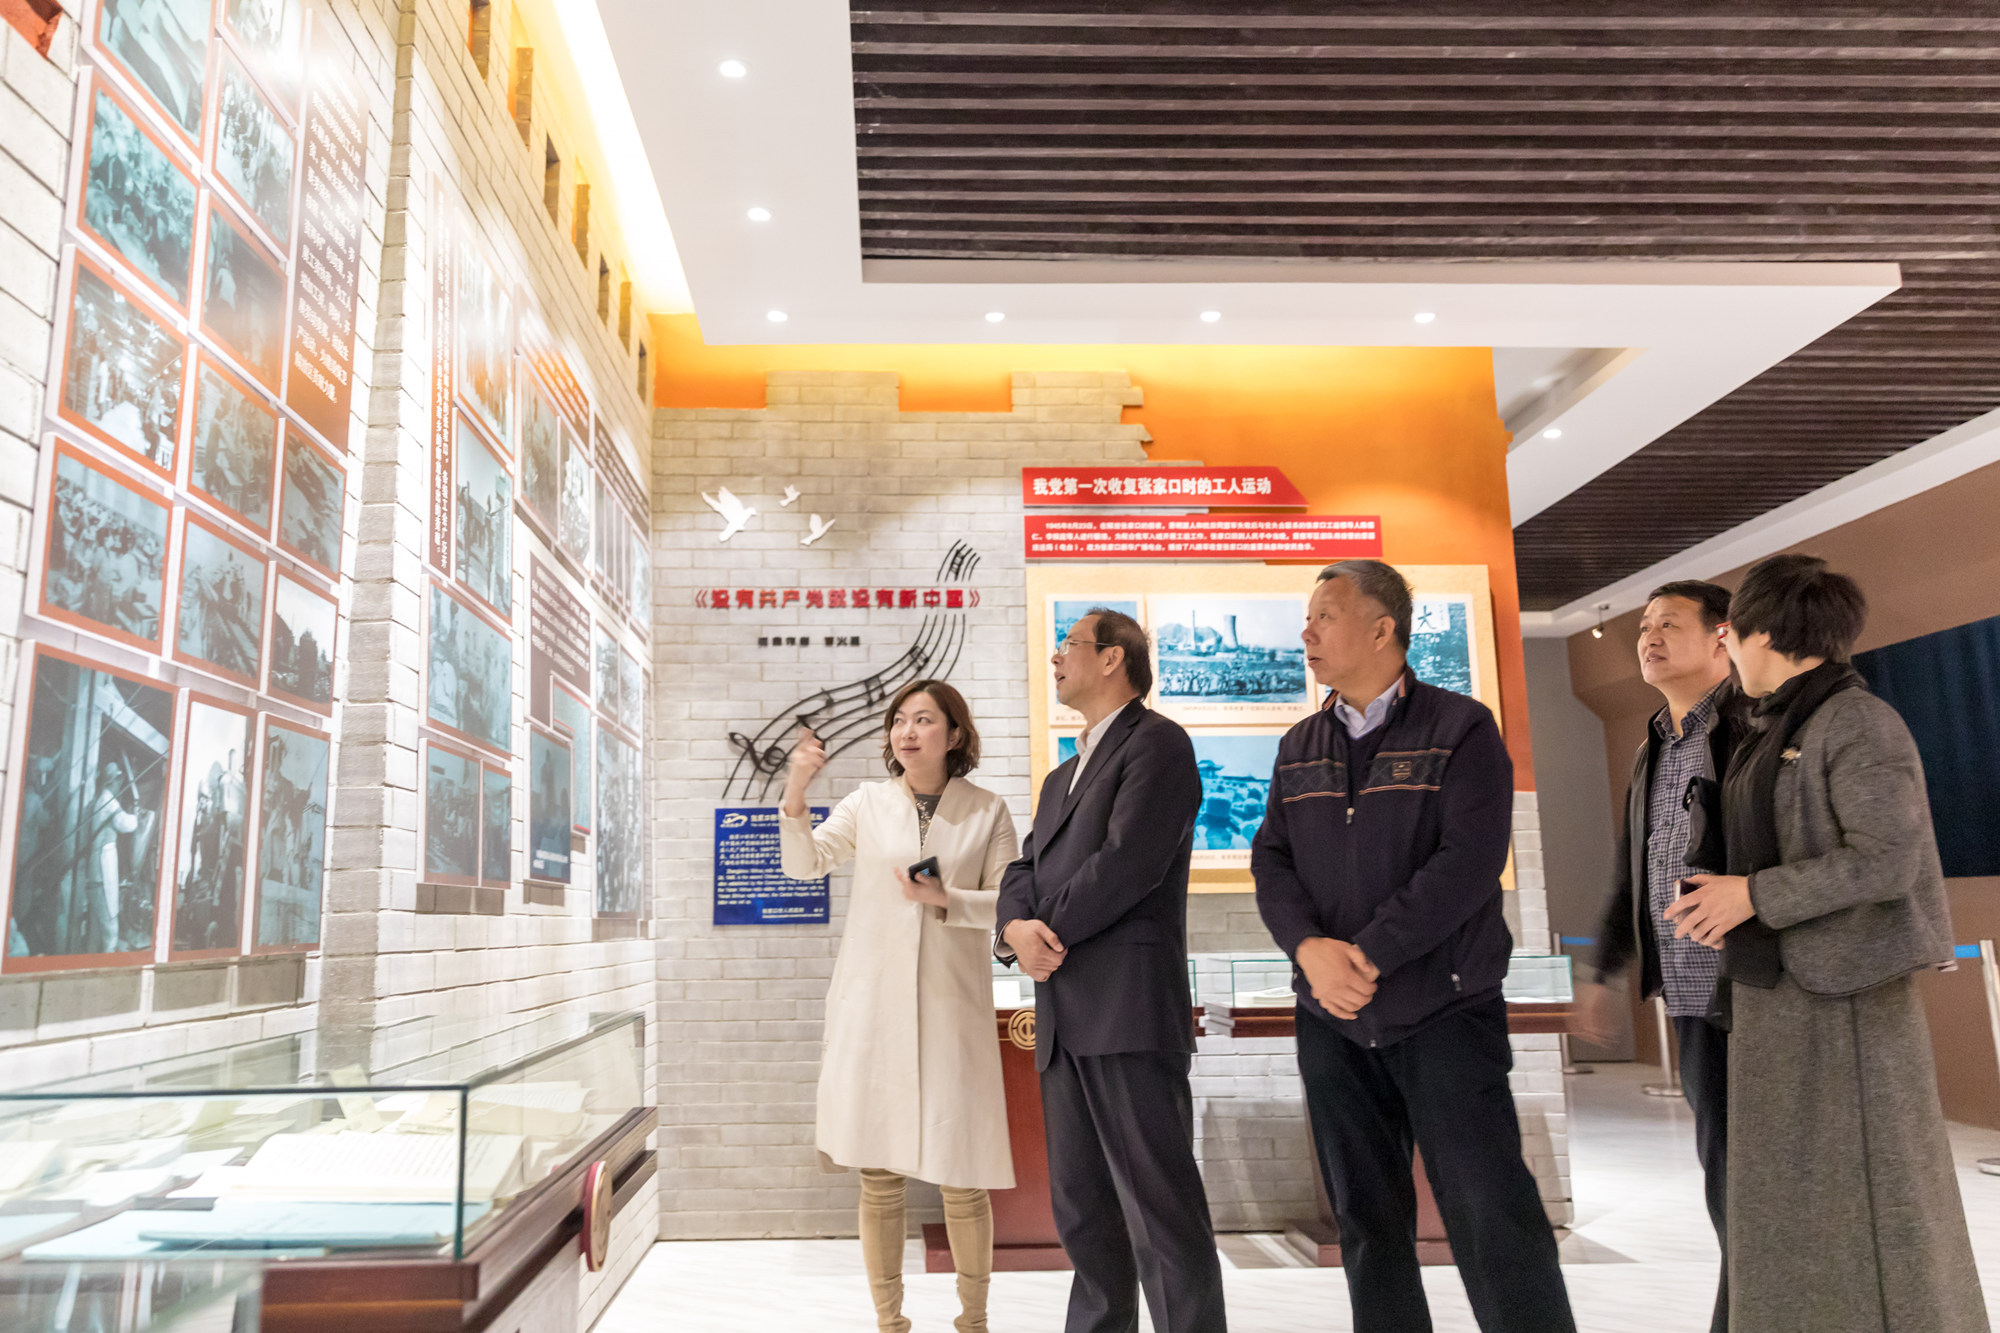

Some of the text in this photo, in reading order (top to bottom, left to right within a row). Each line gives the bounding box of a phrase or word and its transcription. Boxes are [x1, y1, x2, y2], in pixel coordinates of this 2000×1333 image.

[1033, 477, 1272, 495] 我党第一次收复张家口时的工人运动
